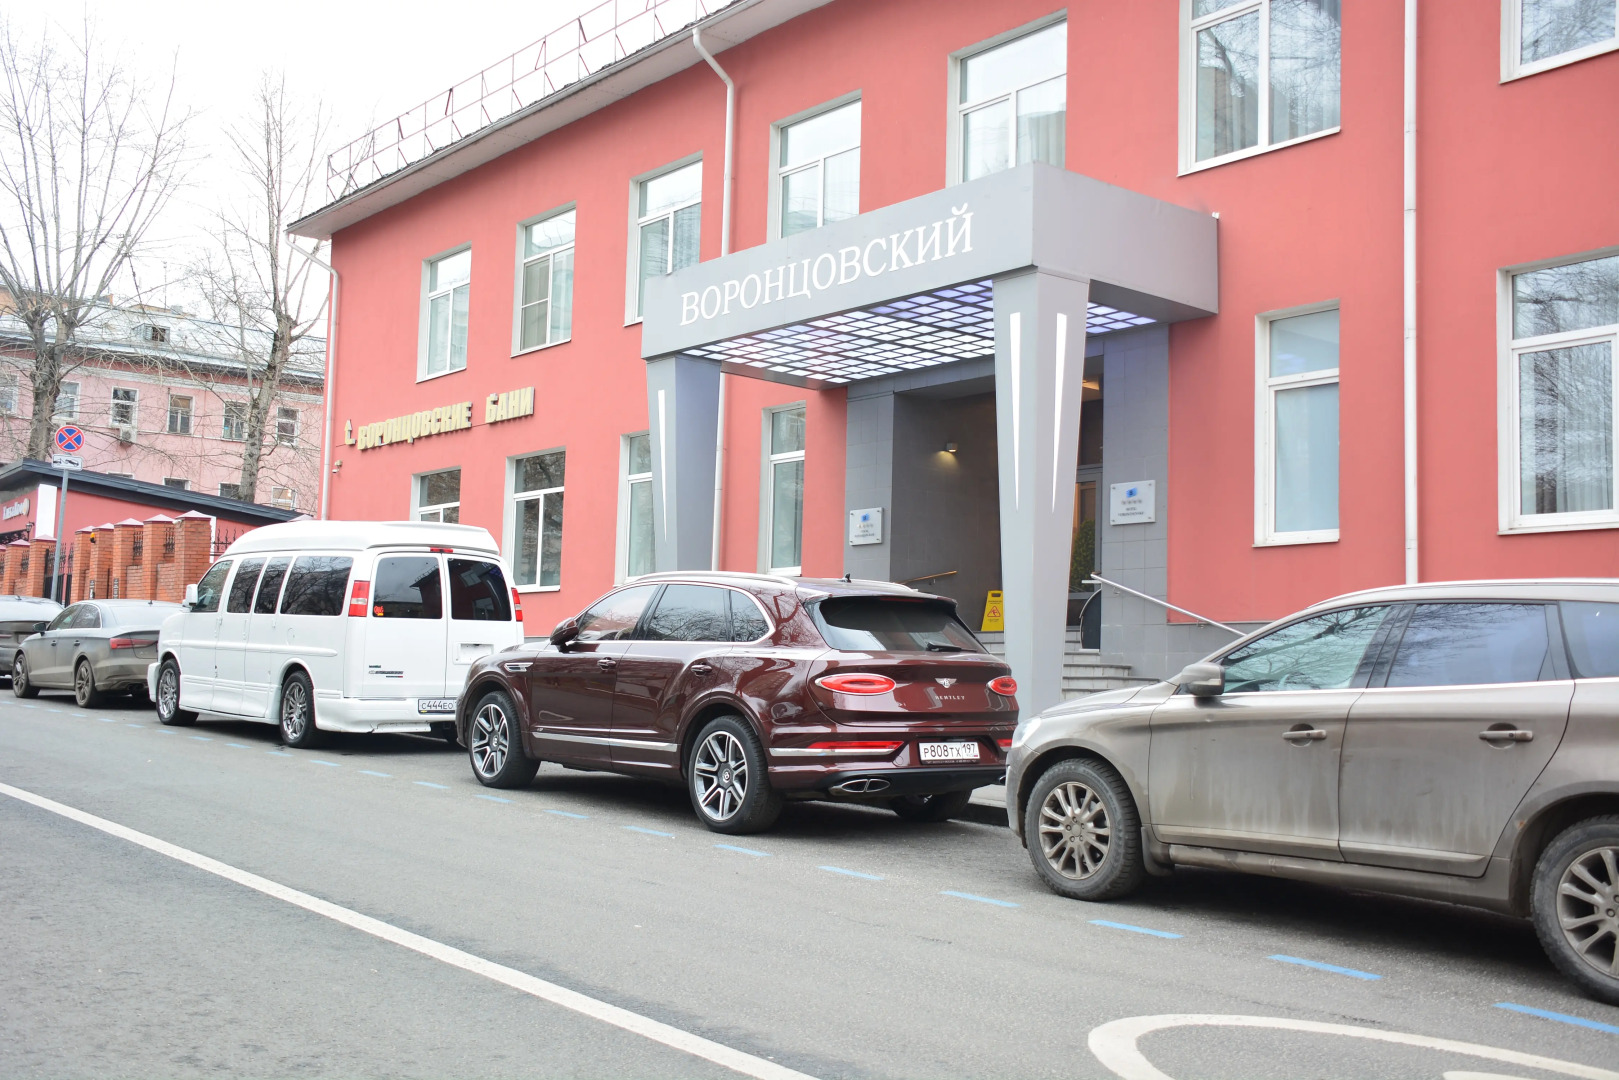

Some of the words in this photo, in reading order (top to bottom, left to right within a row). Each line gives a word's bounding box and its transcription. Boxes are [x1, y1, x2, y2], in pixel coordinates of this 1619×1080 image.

[679, 202, 975, 327] ВОРОНЦОВСКИЙ
[357, 401, 473, 451] ВОРОНЦОВСКИЕ
[485, 386, 535, 424] БАНИ
